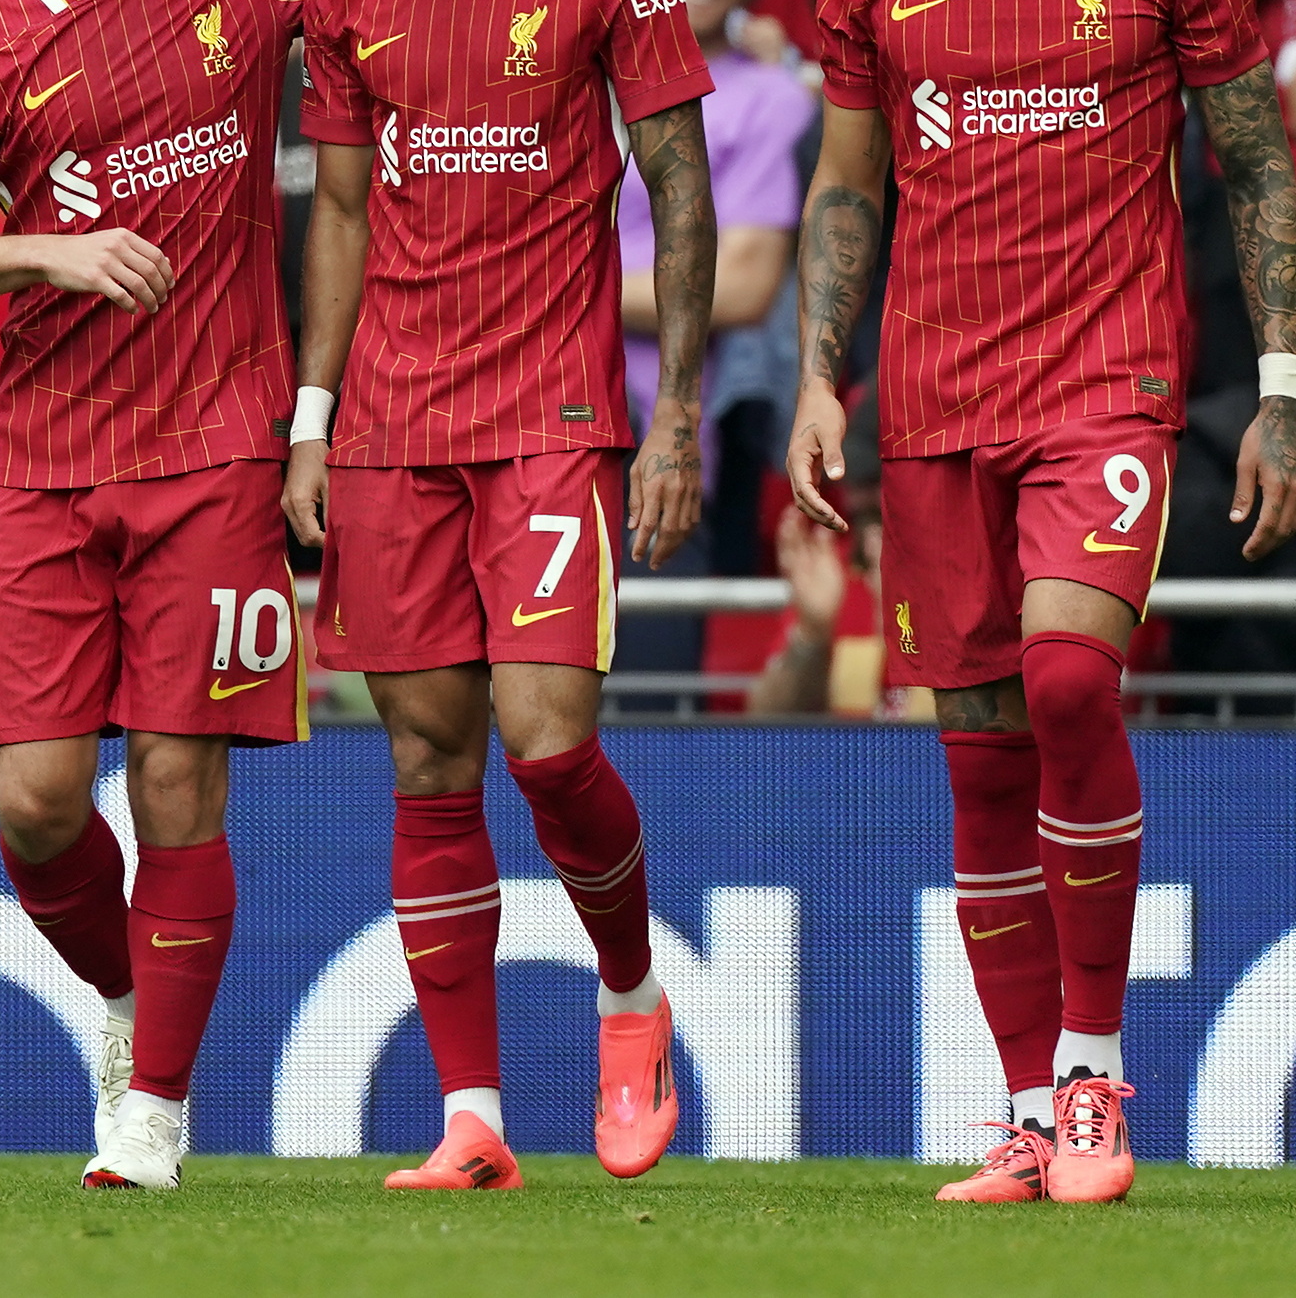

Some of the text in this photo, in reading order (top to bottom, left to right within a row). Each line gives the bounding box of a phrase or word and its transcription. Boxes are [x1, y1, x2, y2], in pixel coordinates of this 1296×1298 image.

[961, 82, 1100, 112] standard
[961, 104, 1106, 136] chartered
[105, 109, 240, 175] standard
[110, 133, 249, 200] chartered
[408, 121, 540, 149] standard
[408, 146, 549, 176] chartered
[1102, 453, 1151, 534] 9
[529, 514, 581, 598] 7
[211, 588, 292, 672] 10
